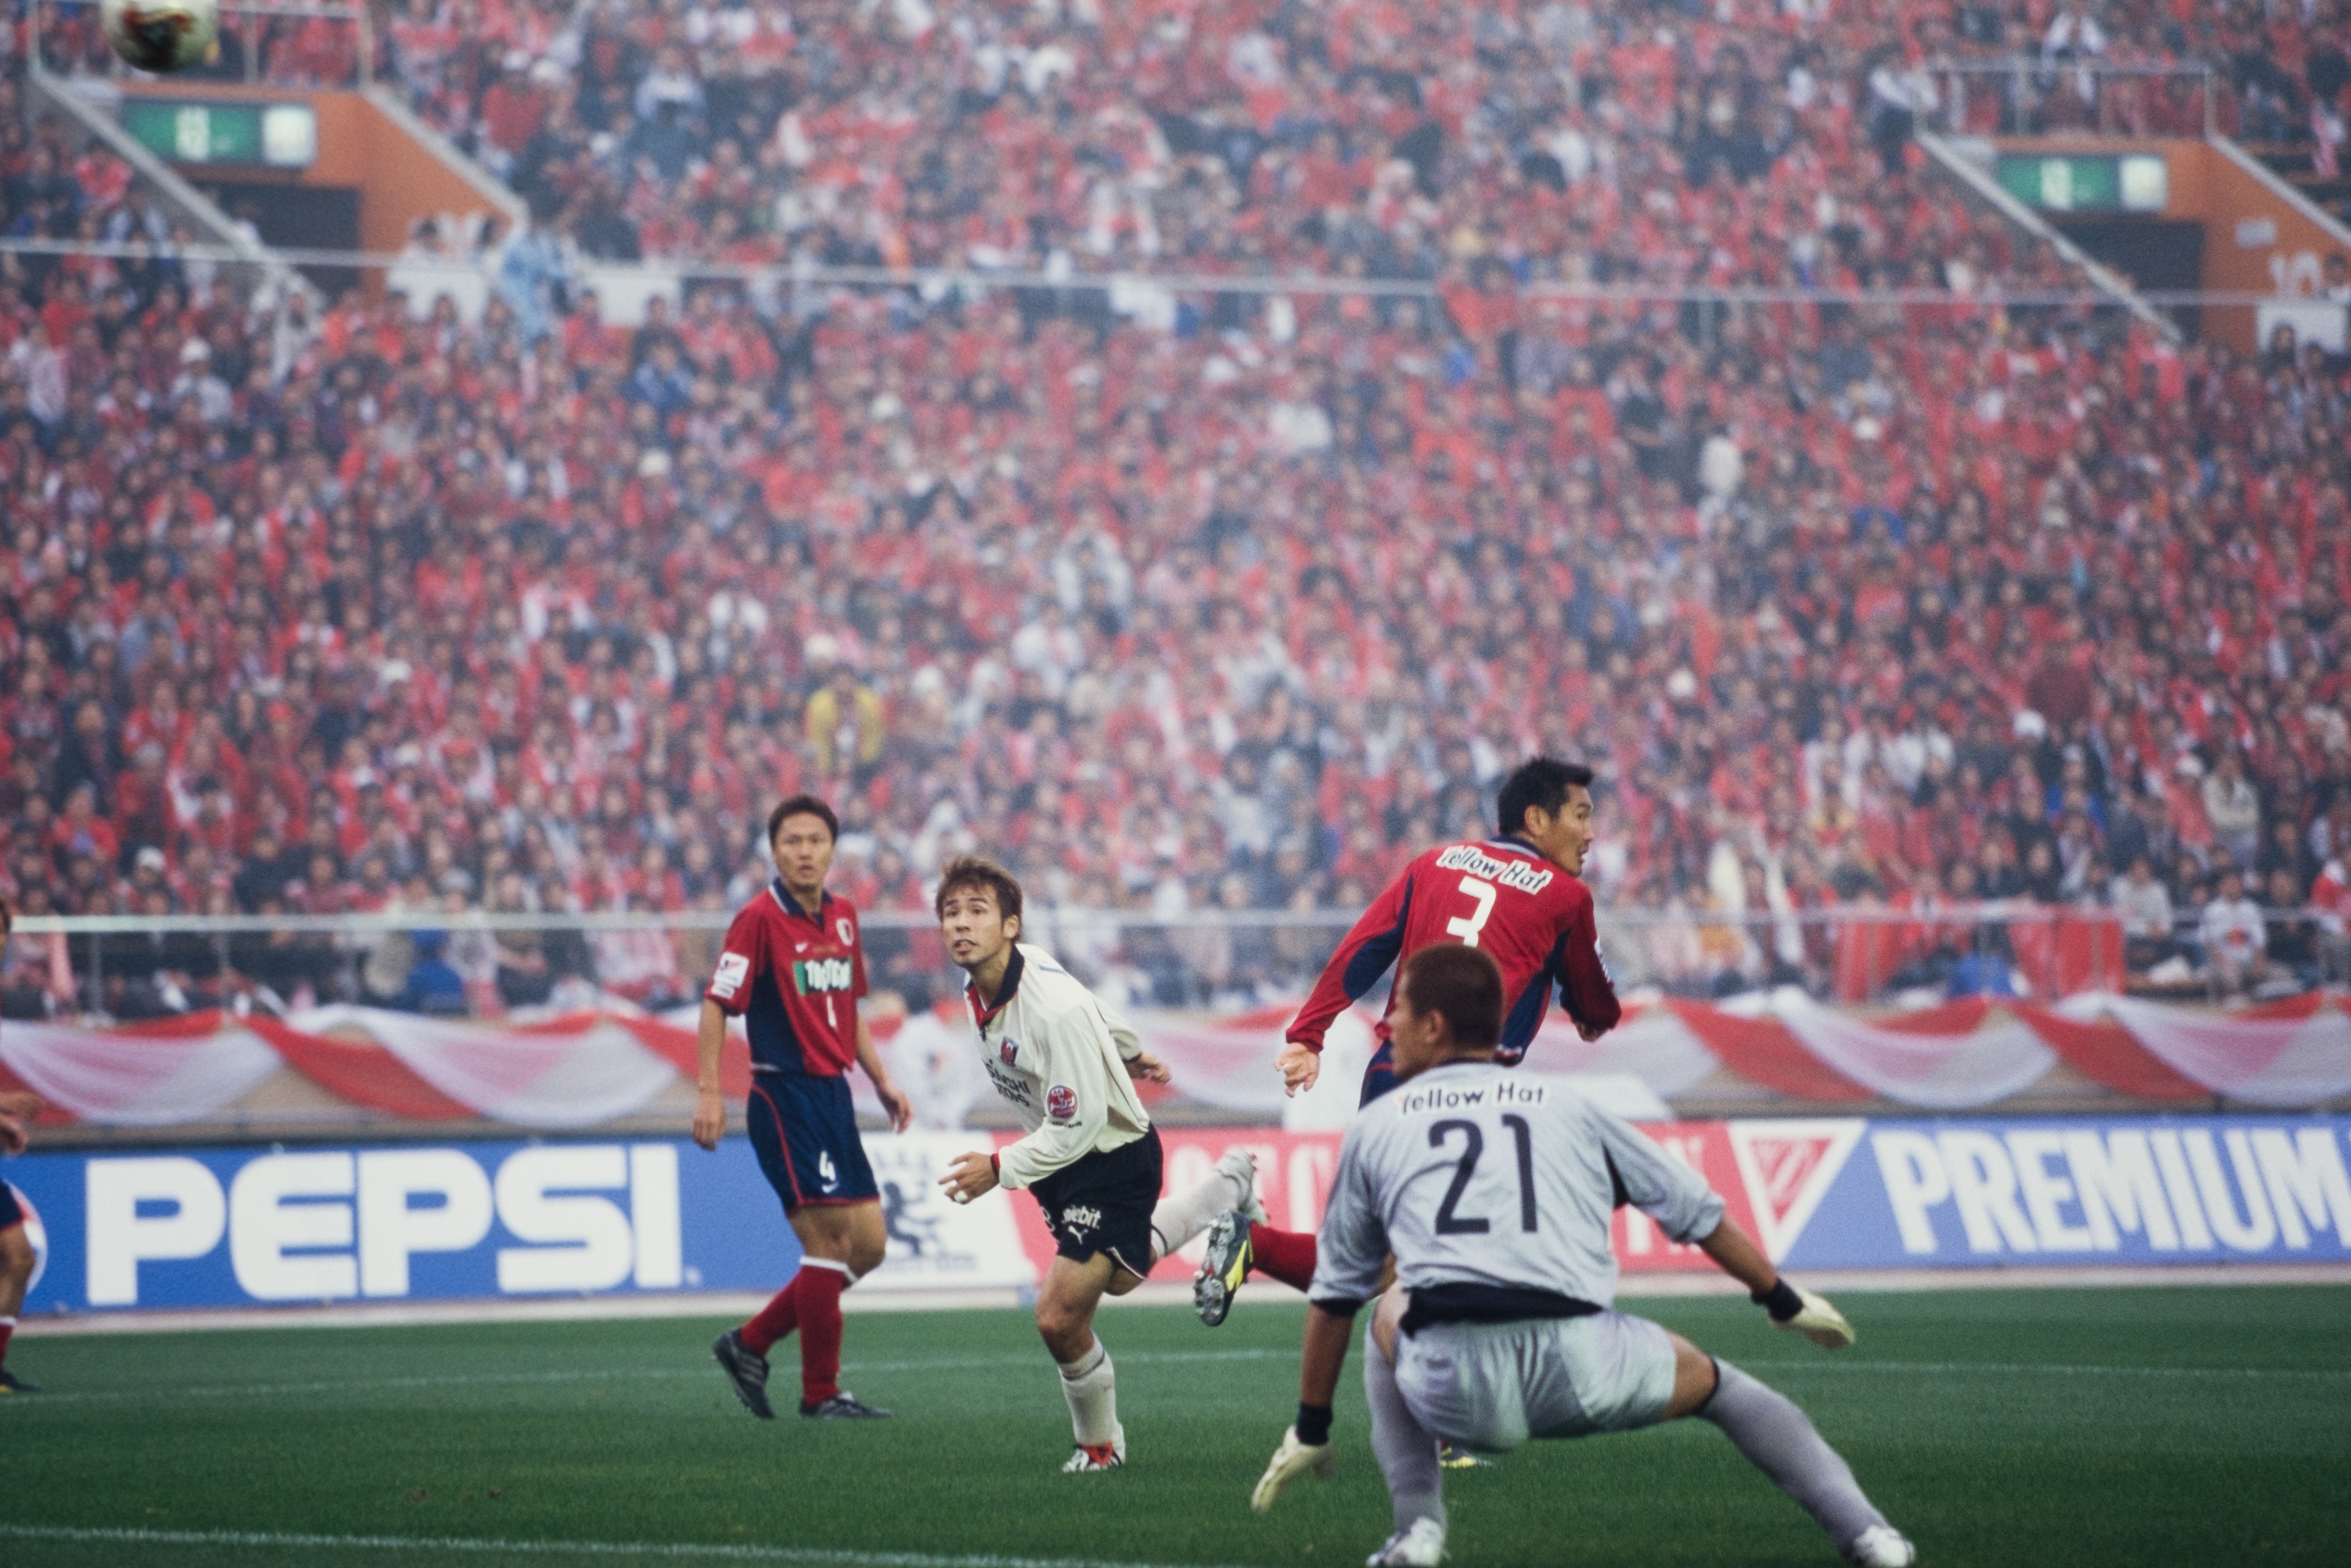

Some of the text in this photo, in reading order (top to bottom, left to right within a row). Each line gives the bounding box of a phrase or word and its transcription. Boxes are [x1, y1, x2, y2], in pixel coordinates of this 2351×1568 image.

[1498, 1080, 1543, 1105] Hat
[86, 1143, 682, 1306] PEPSI
[819, 1150, 837, 1181] 4
[1428, 1113, 1538, 1234] 21
[1872, 1127, 2351, 1254] PREMIUM
